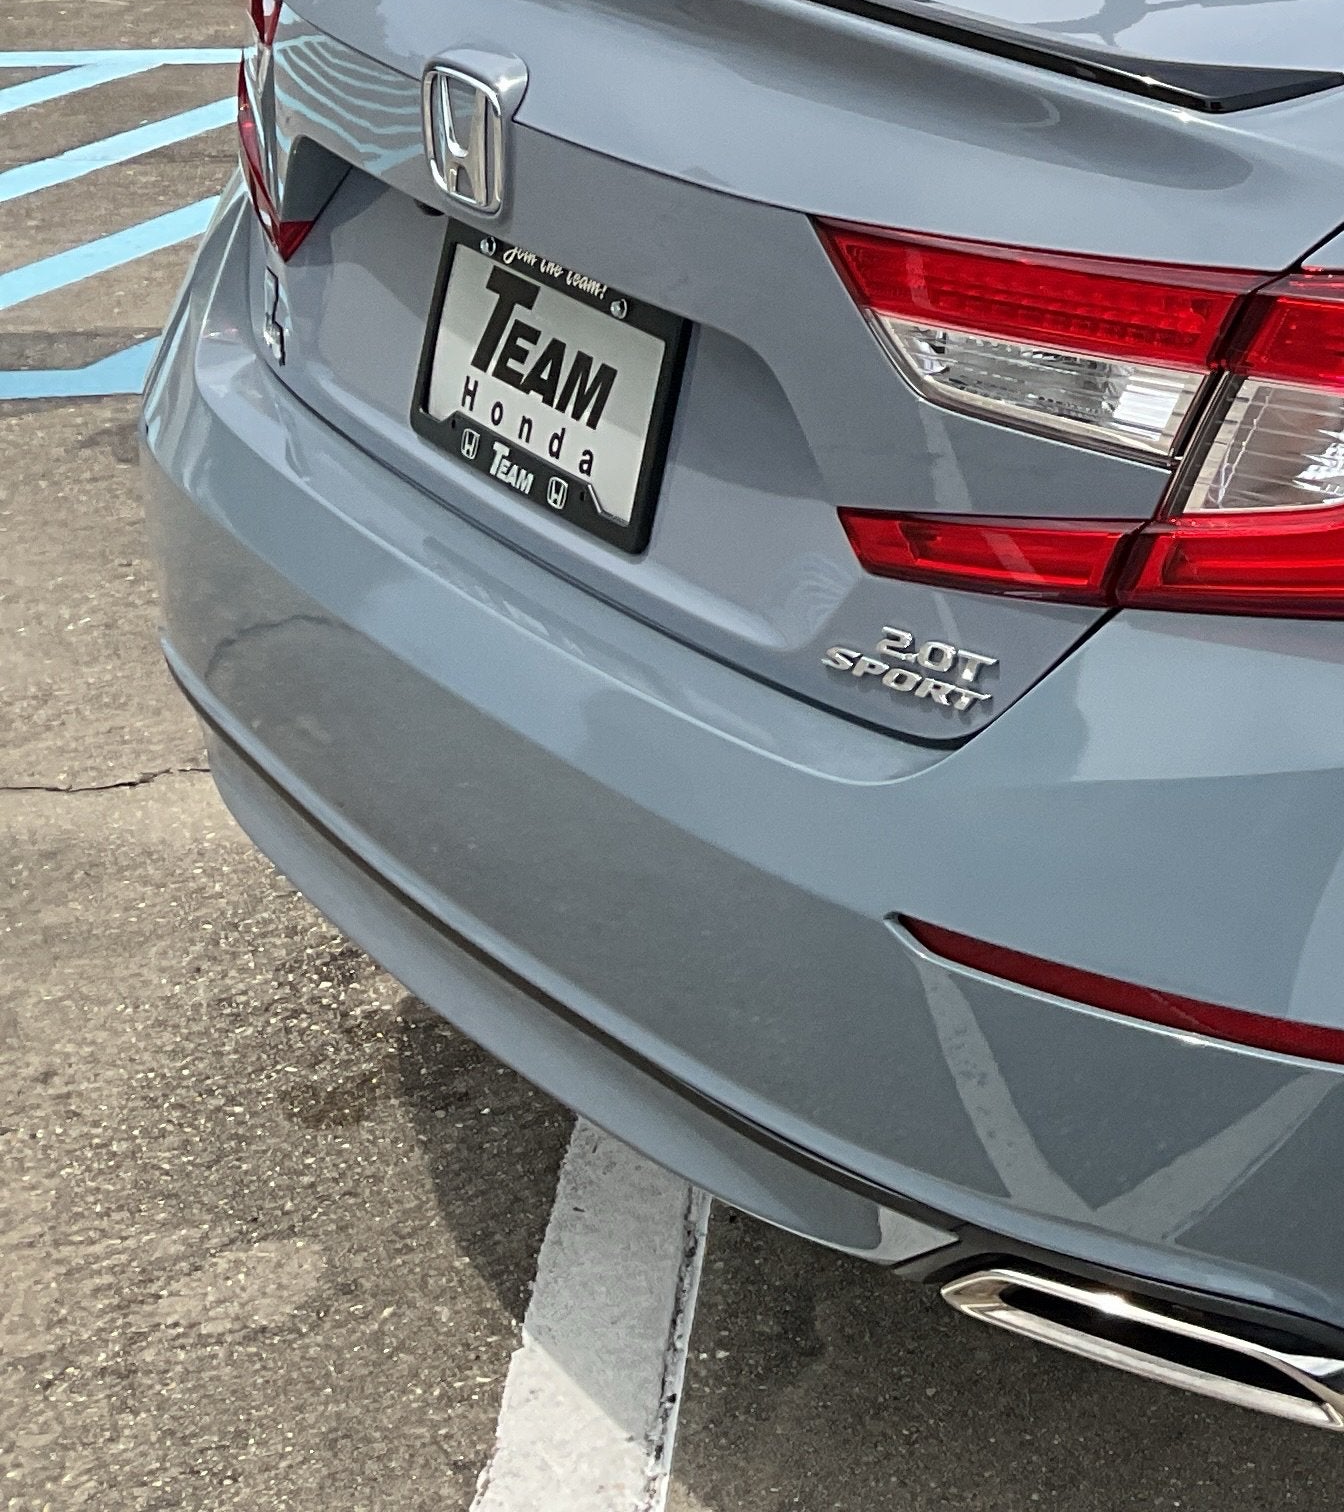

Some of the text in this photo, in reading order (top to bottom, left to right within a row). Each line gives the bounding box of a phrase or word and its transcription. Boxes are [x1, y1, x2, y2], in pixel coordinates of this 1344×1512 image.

[470, 264, 619, 431] TEAM
[461, 375, 595, 478] Honda
[488, 441, 535, 495] TEAM
[821, 646, 993, 712] SPORT
[876, 625, 999, 682] 2.0T
